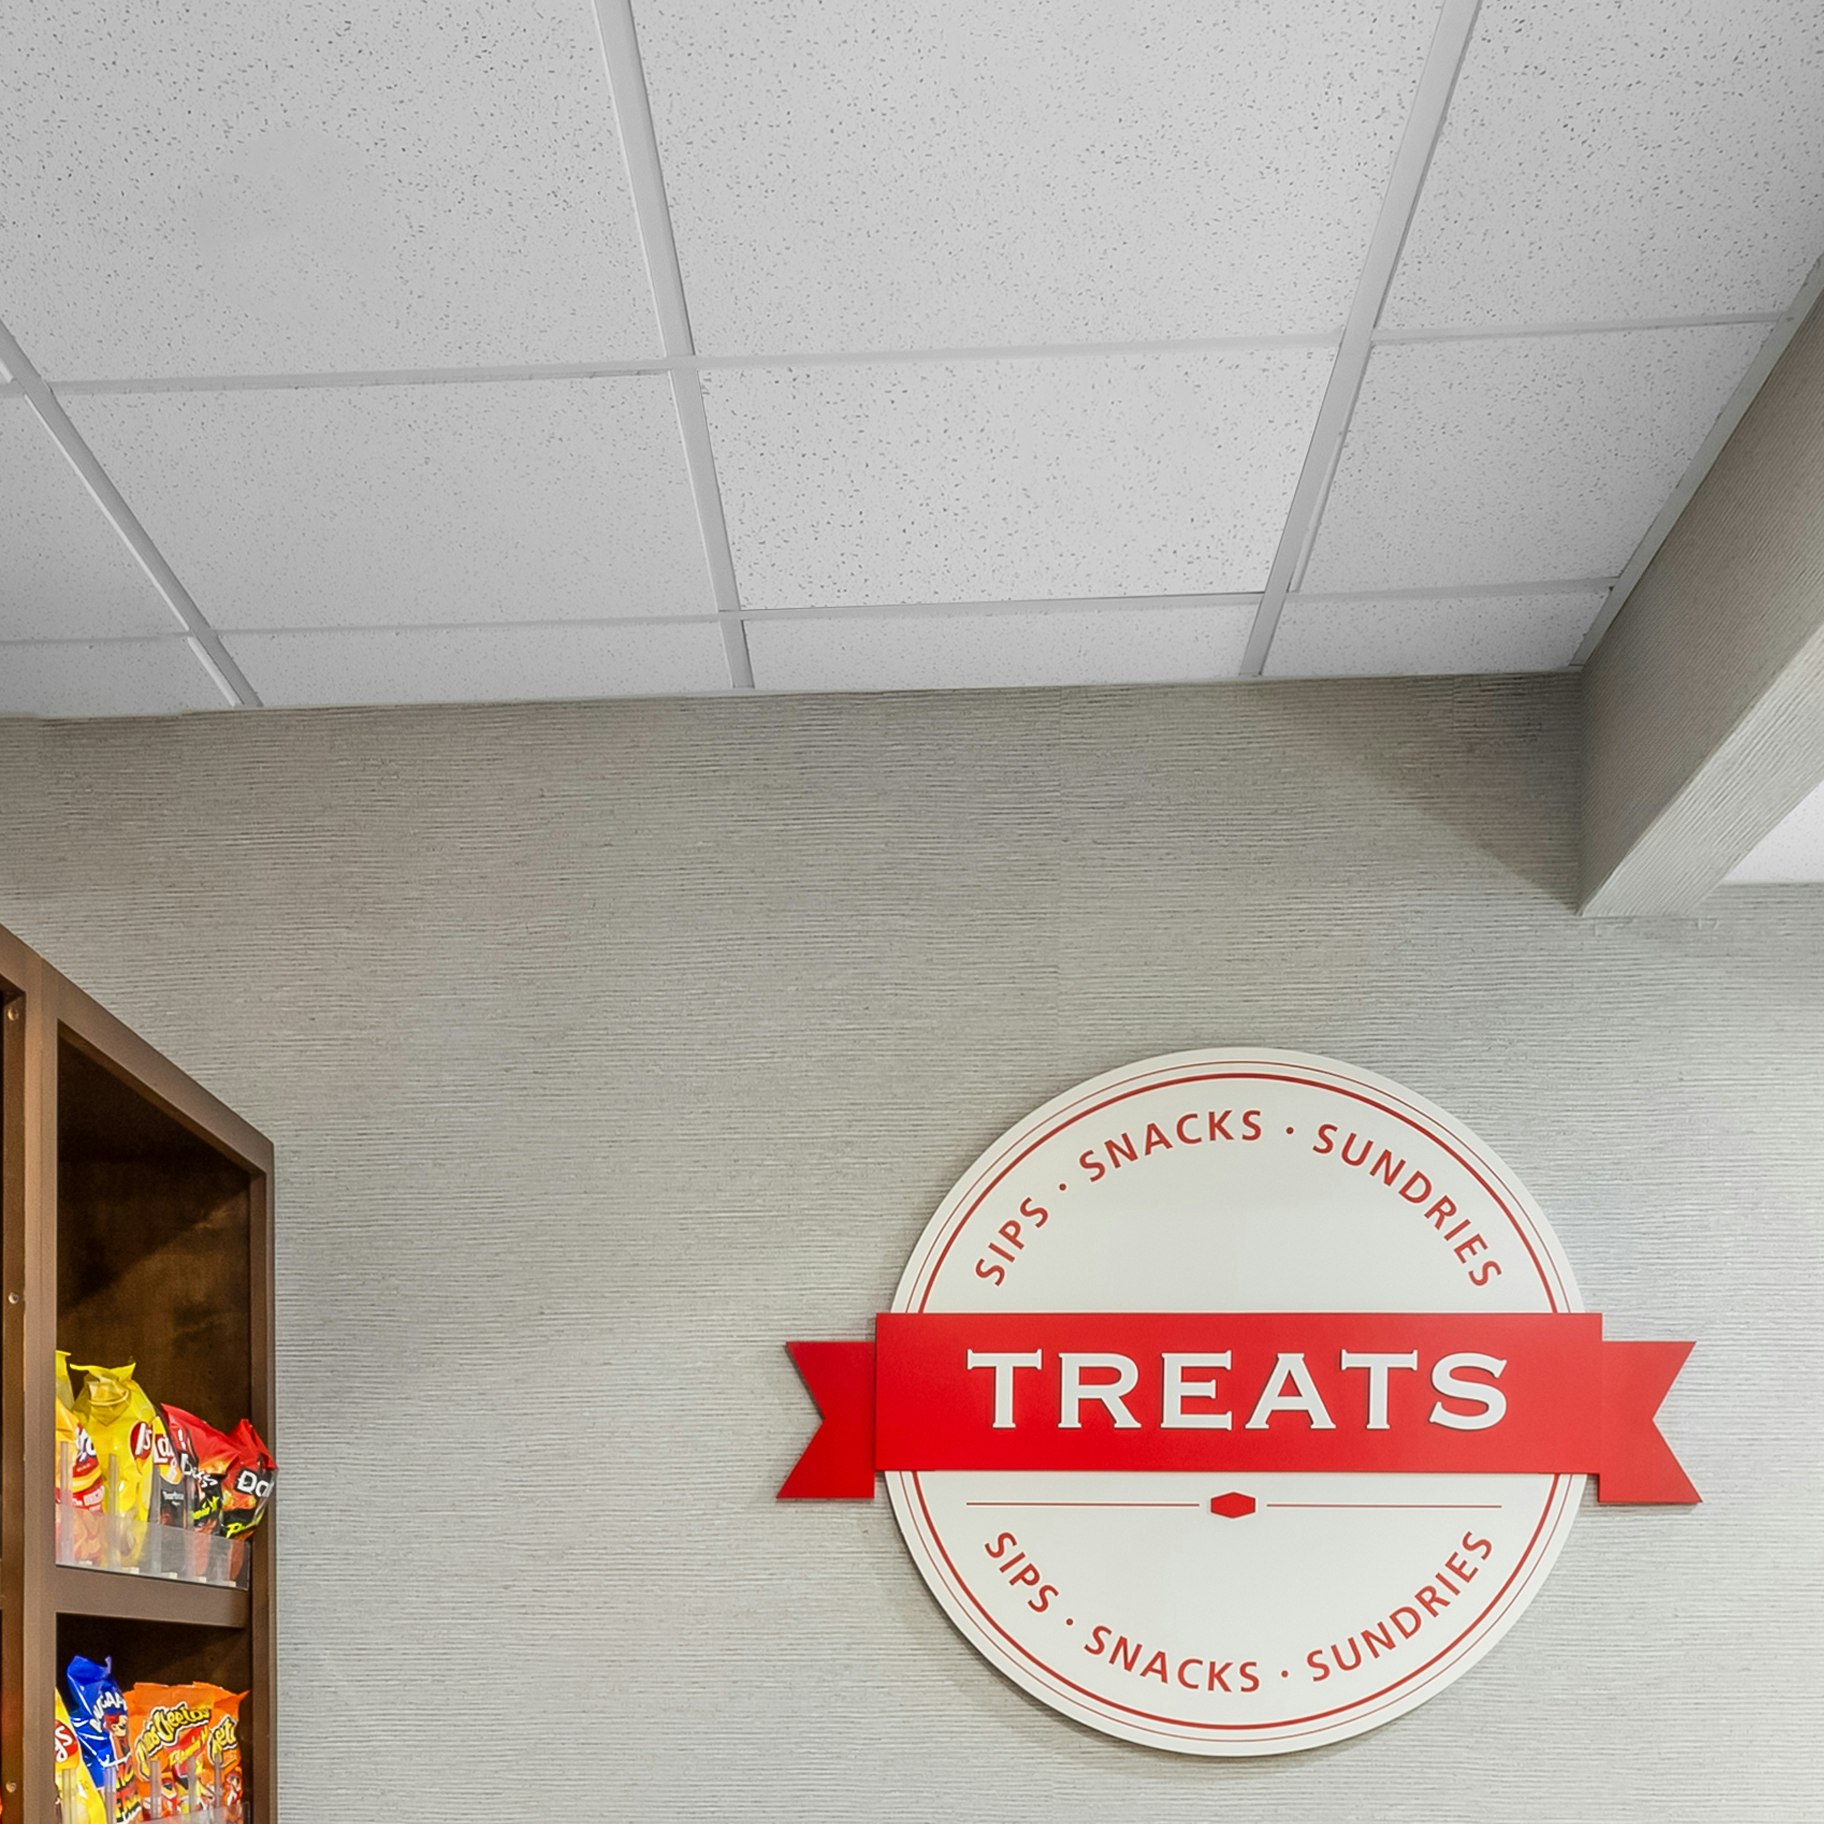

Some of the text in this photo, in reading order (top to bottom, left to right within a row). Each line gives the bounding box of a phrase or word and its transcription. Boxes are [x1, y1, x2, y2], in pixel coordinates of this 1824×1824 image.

[975, 1108, 1503, 1289] SIPS SNACKS SUNDRIES
[966, 1348, 1509, 1433] TREATS
[985, 1531, 1494, 1694] SIPS SNACKS SUNDRIES
